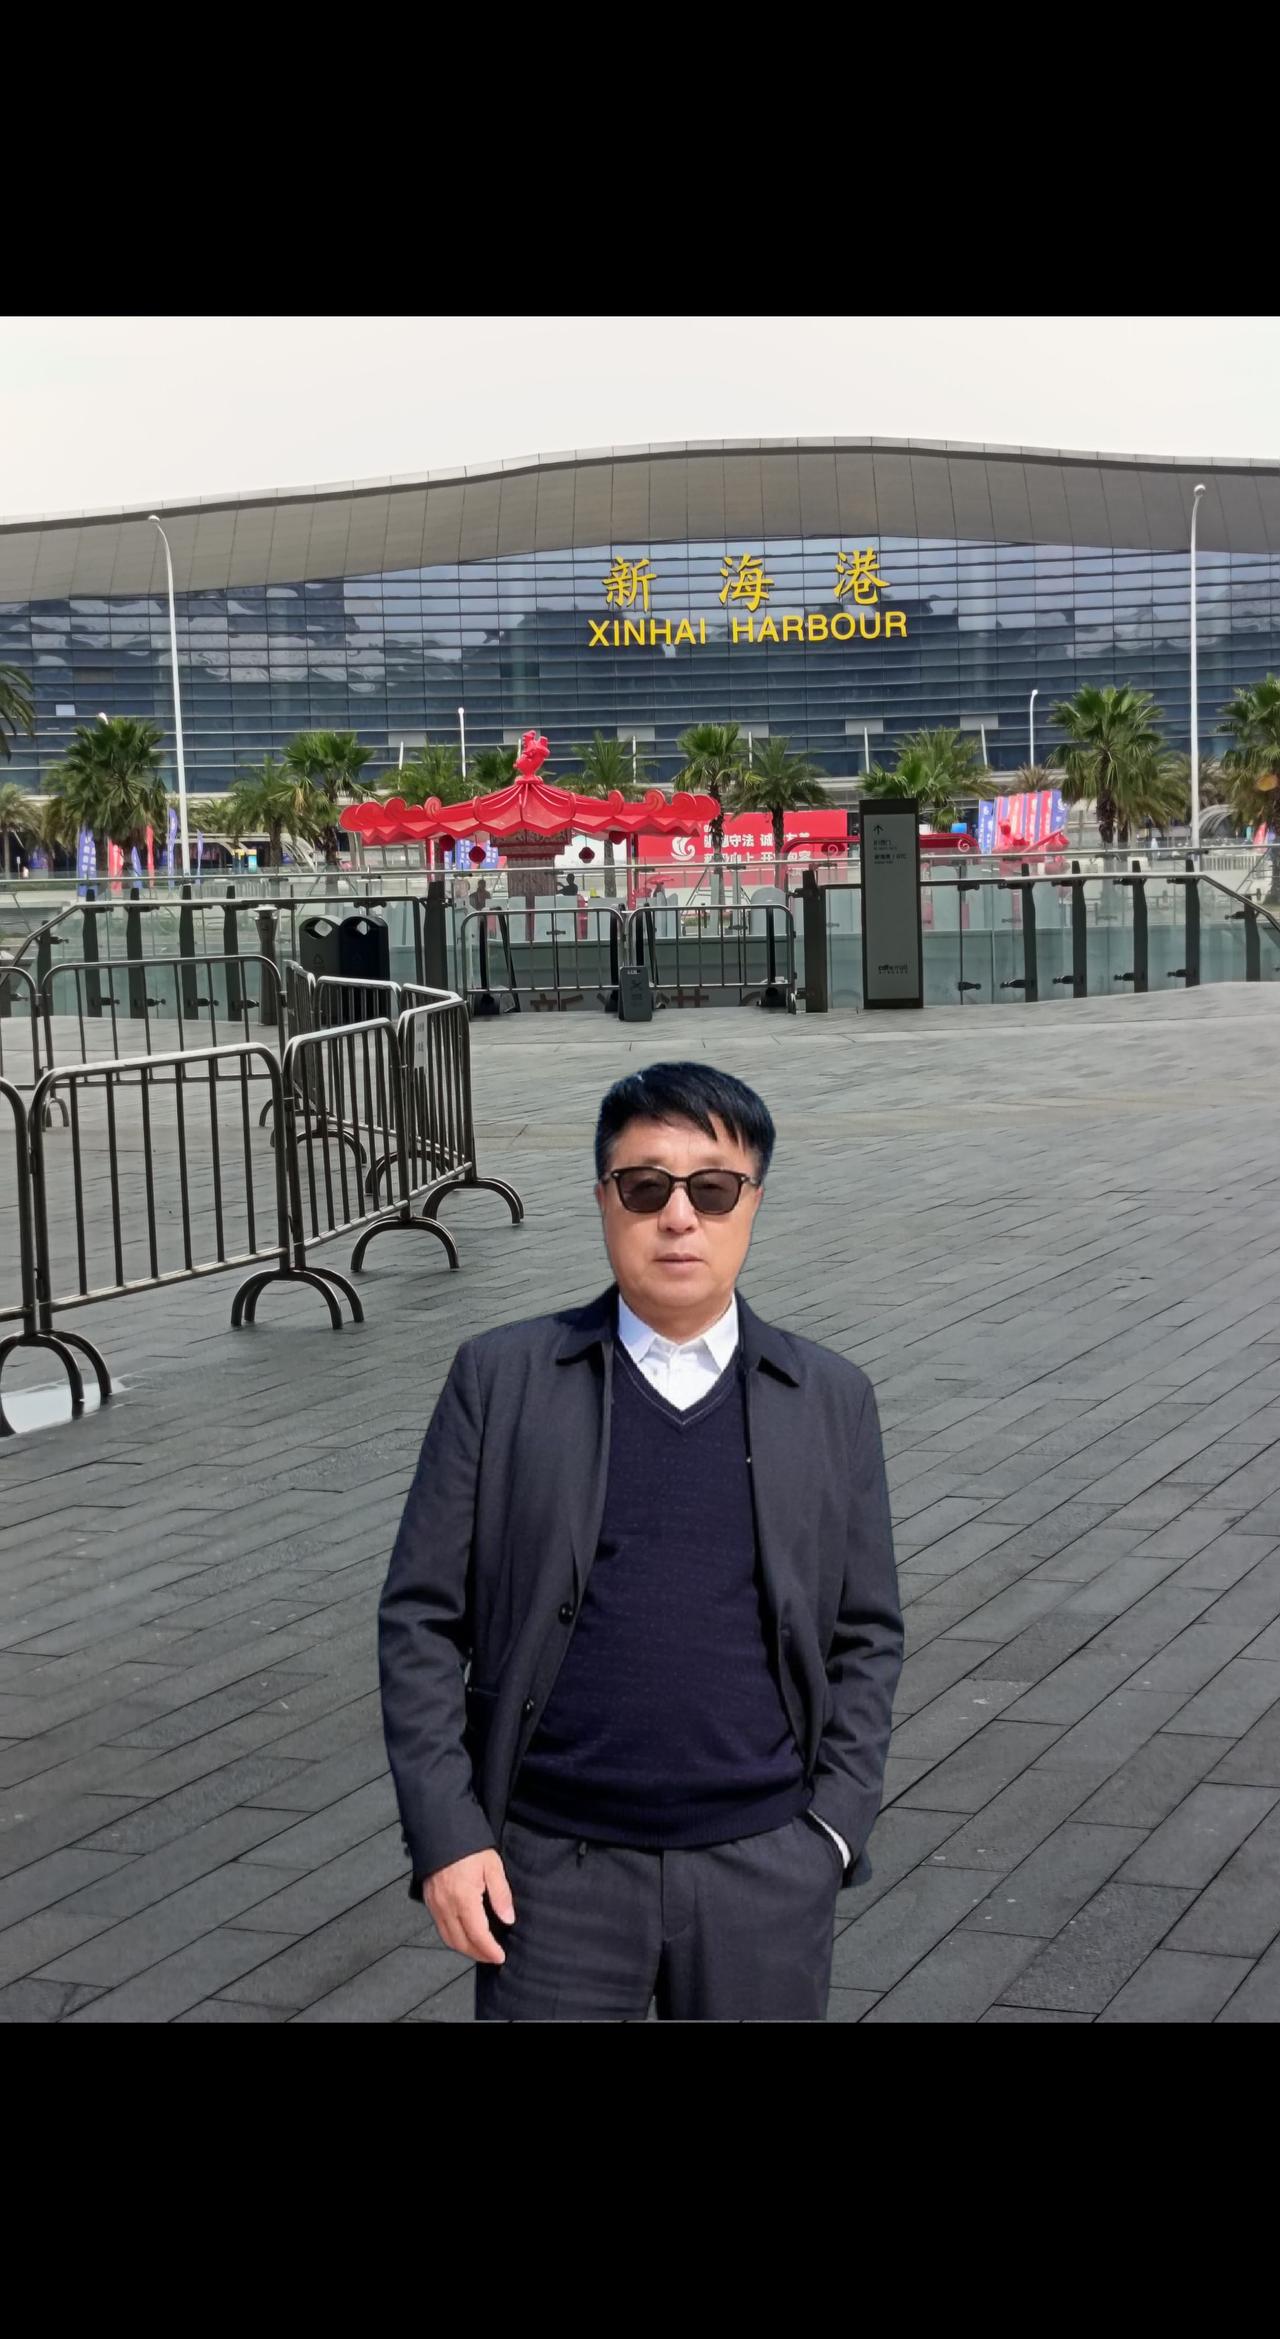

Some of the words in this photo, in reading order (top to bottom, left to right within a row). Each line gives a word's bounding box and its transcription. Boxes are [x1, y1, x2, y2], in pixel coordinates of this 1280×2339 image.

[601, 548, 891, 612] 新海港
[588, 619, 706, 647] XINHAI
[732, 612, 908, 643] HARBOUR
